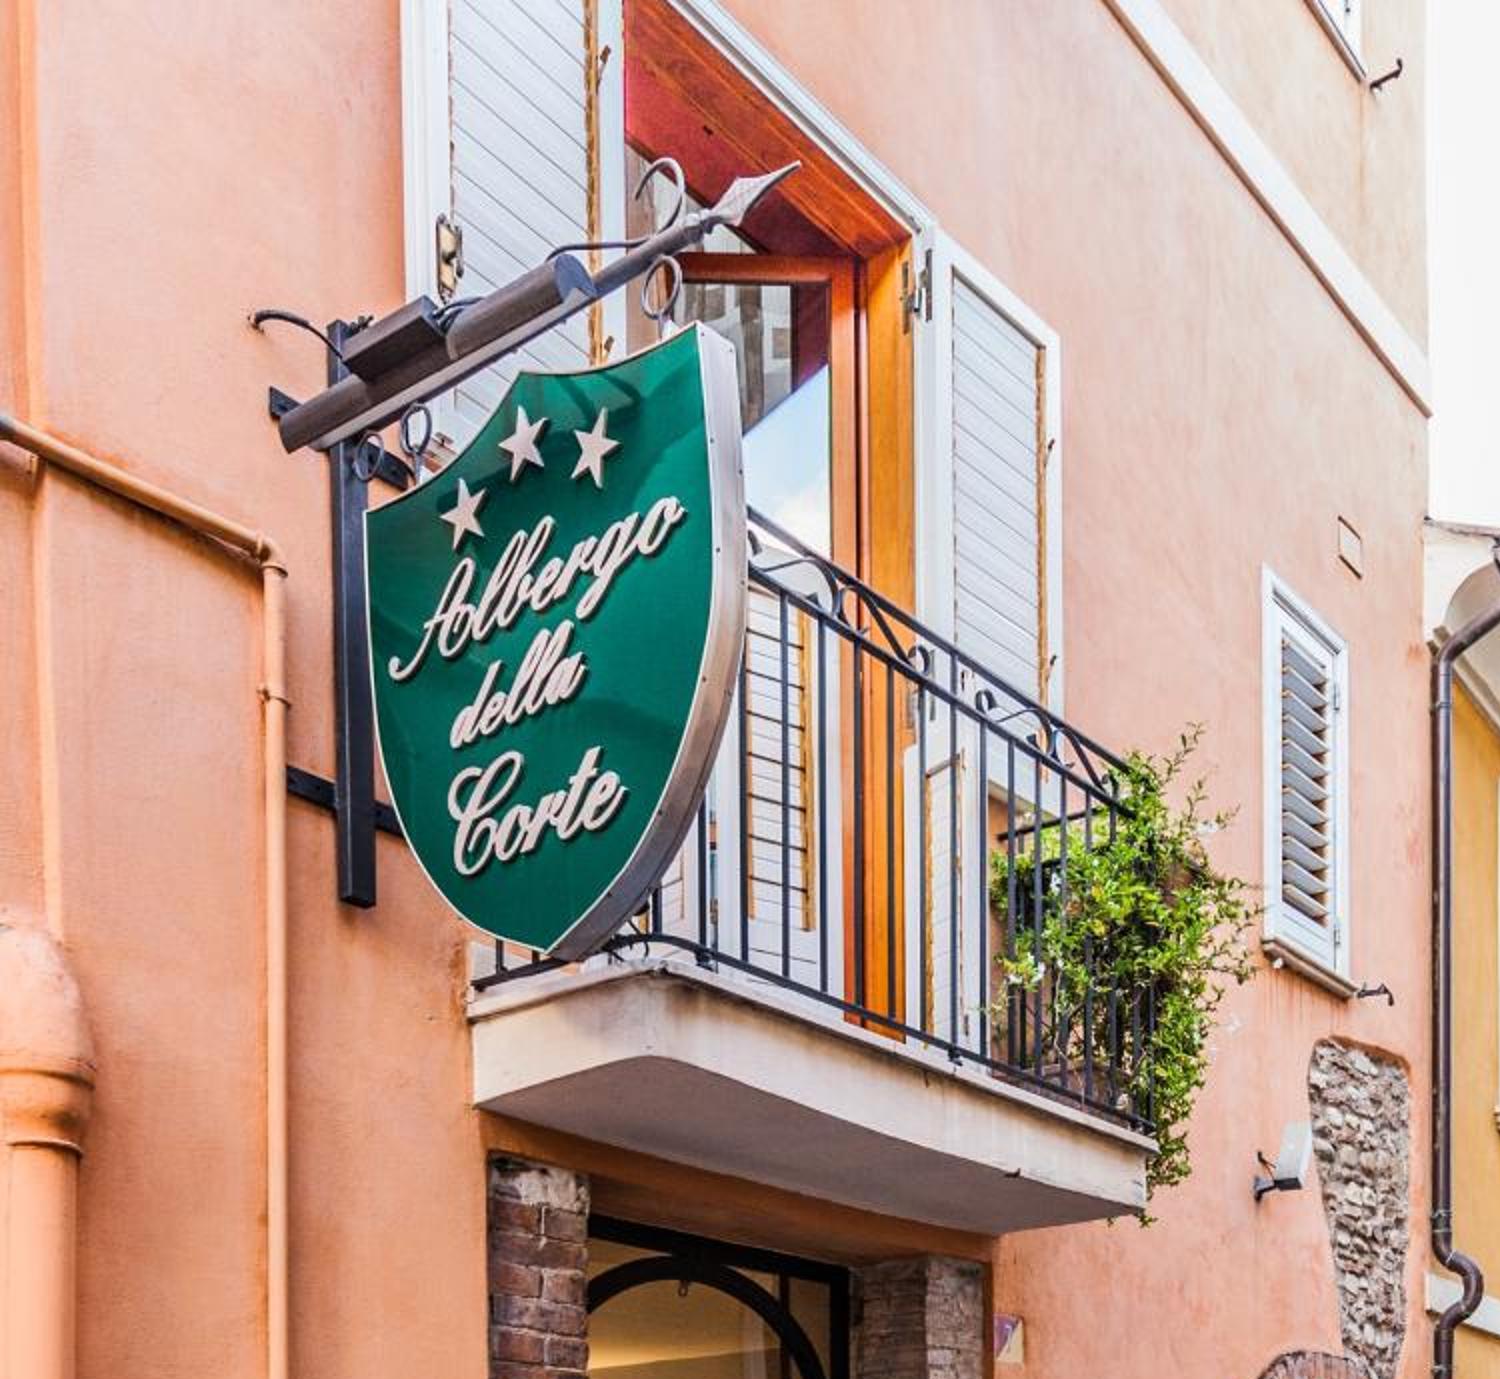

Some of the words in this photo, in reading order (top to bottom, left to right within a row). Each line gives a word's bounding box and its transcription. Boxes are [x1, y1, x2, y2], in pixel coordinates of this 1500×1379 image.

[388, 496, 686, 681] Albergo
[450, 619, 587, 749] della
[447, 745, 627, 877] Corte
